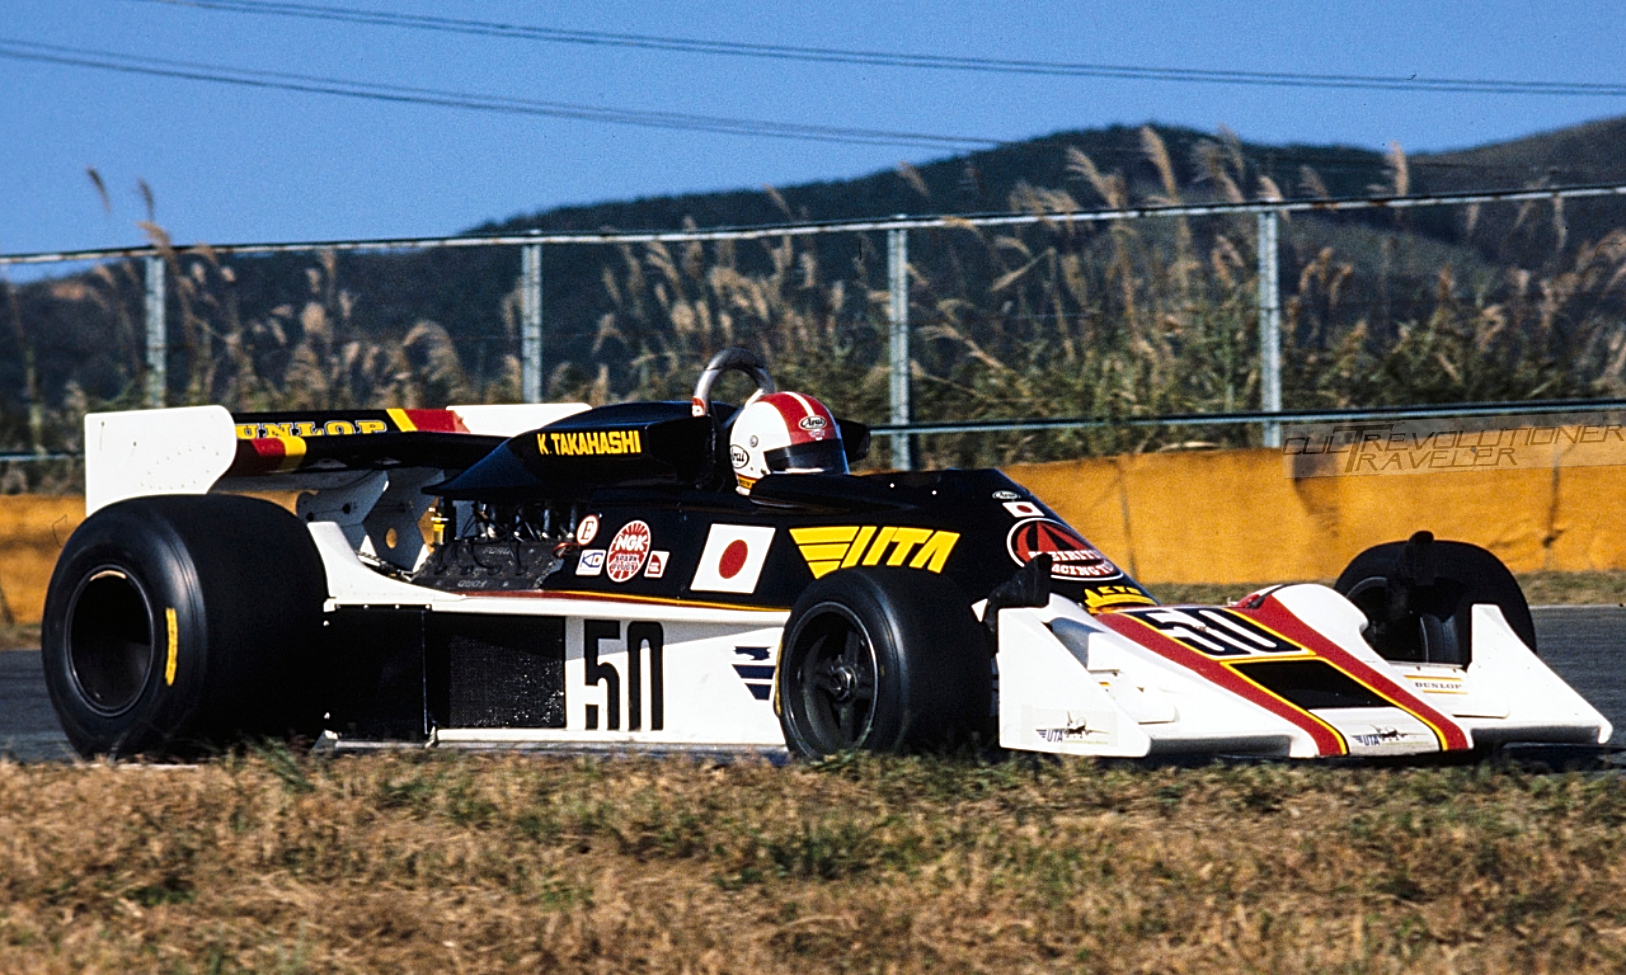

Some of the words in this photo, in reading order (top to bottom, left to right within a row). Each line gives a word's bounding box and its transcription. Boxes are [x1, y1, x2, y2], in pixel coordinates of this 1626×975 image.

[235, 420, 388, 440] UNLOP
[550, 430, 642, 456] TAKAHASHI
[615, 534, 648, 551] NGK
[1122, 608, 1303, 656] 50
[584, 619, 664, 731] 50
[1415, 681, 1462, 690] DUNLOP
[1046, 729, 1063, 743] UTA
[1362, 734, 1380, 747] UTA
